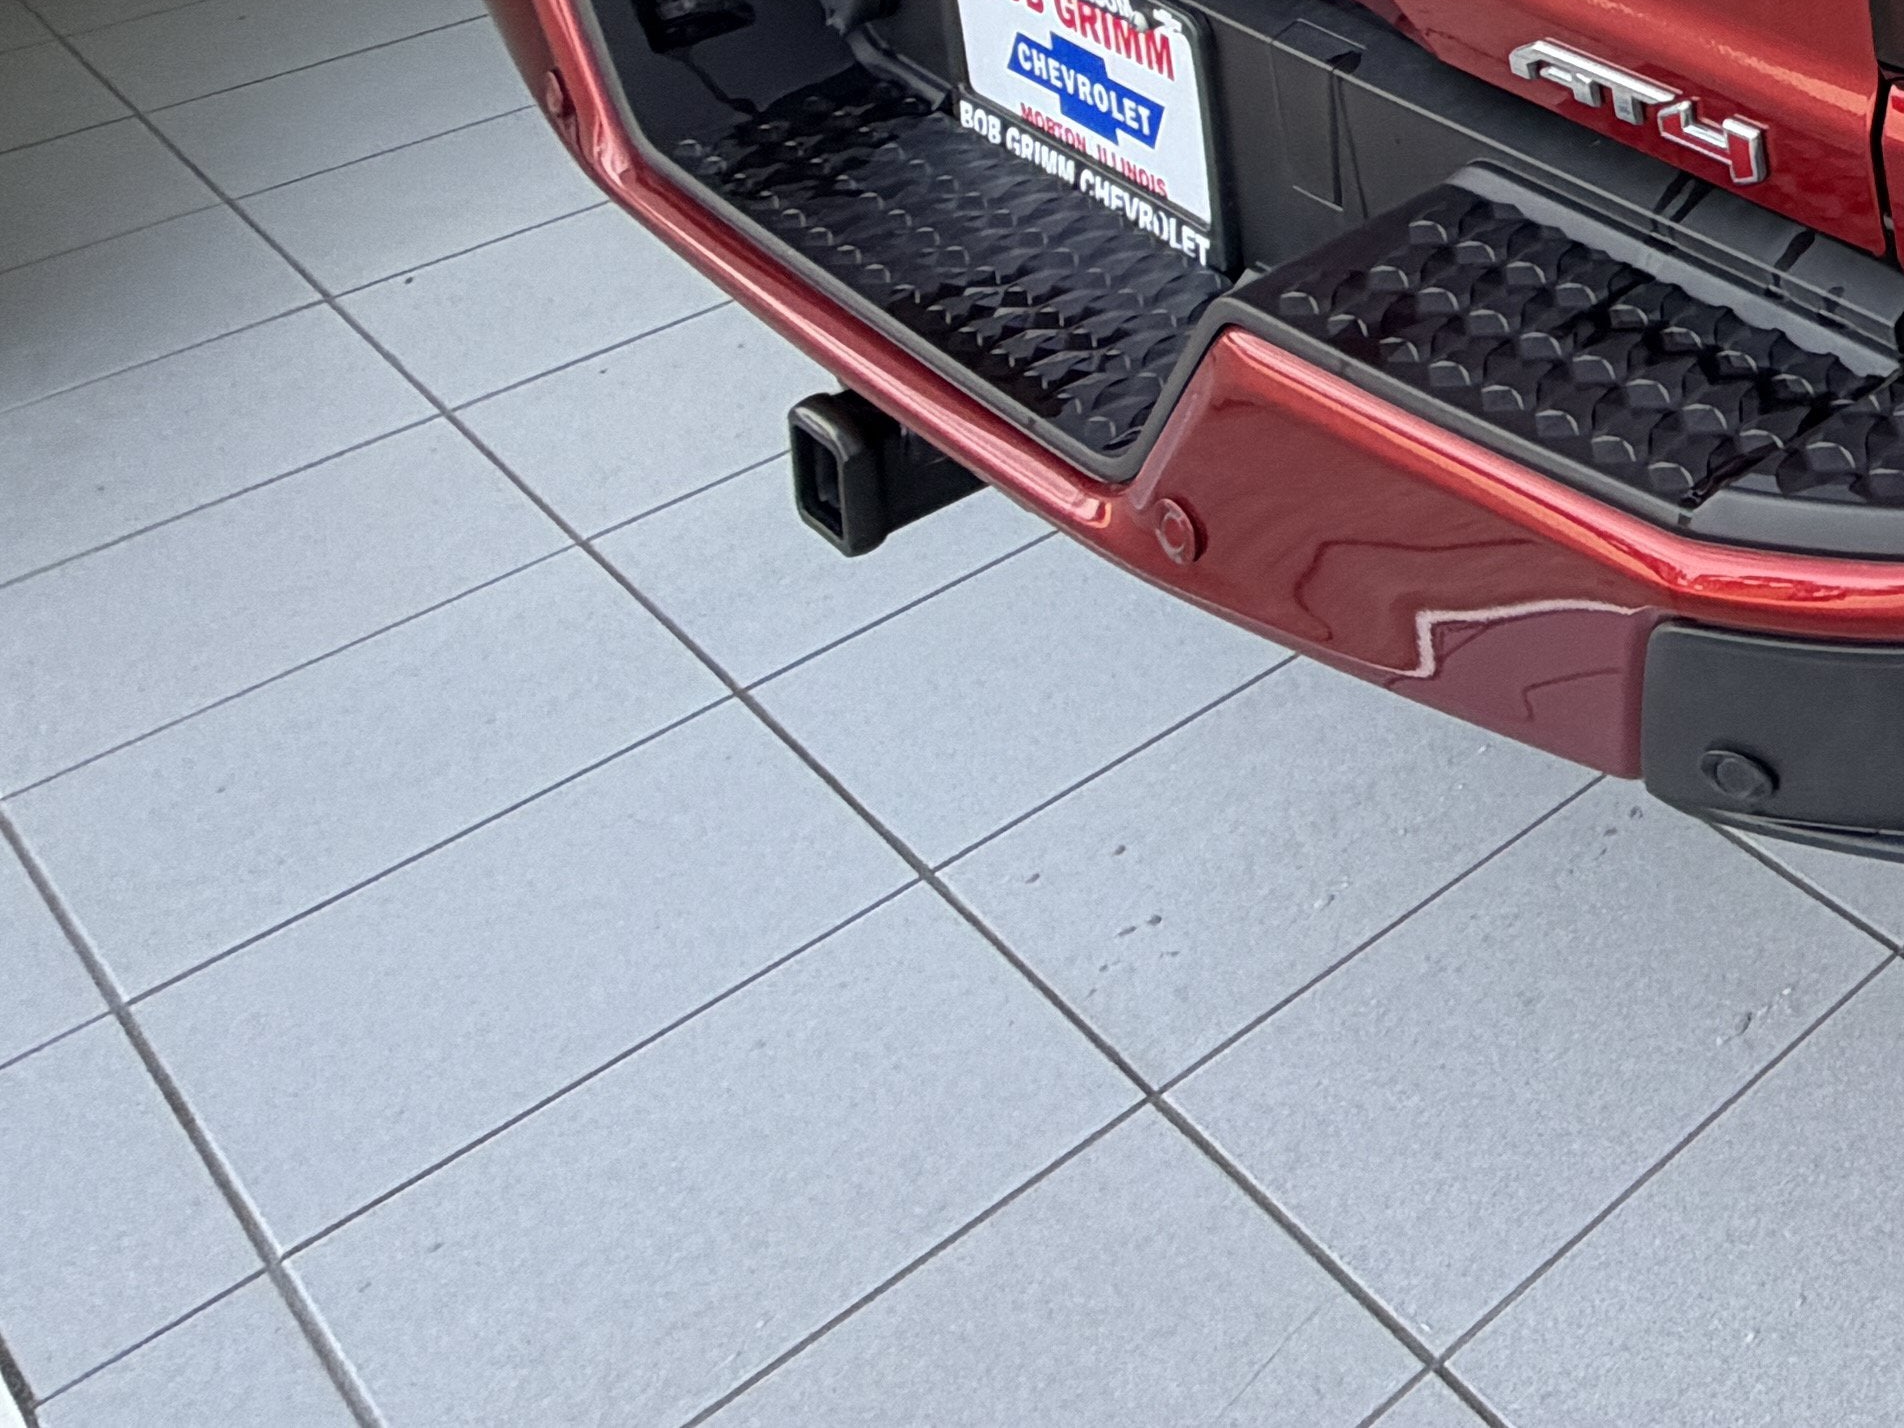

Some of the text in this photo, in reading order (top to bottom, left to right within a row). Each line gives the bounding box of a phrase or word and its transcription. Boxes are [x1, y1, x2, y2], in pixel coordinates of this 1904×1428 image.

[1018, 41, 1151, 136] CHEVROLET
[1509, 40, 1766, 185] AT4
[959, 99, 1211, 267] BOB GRIMM CHEVROLET
